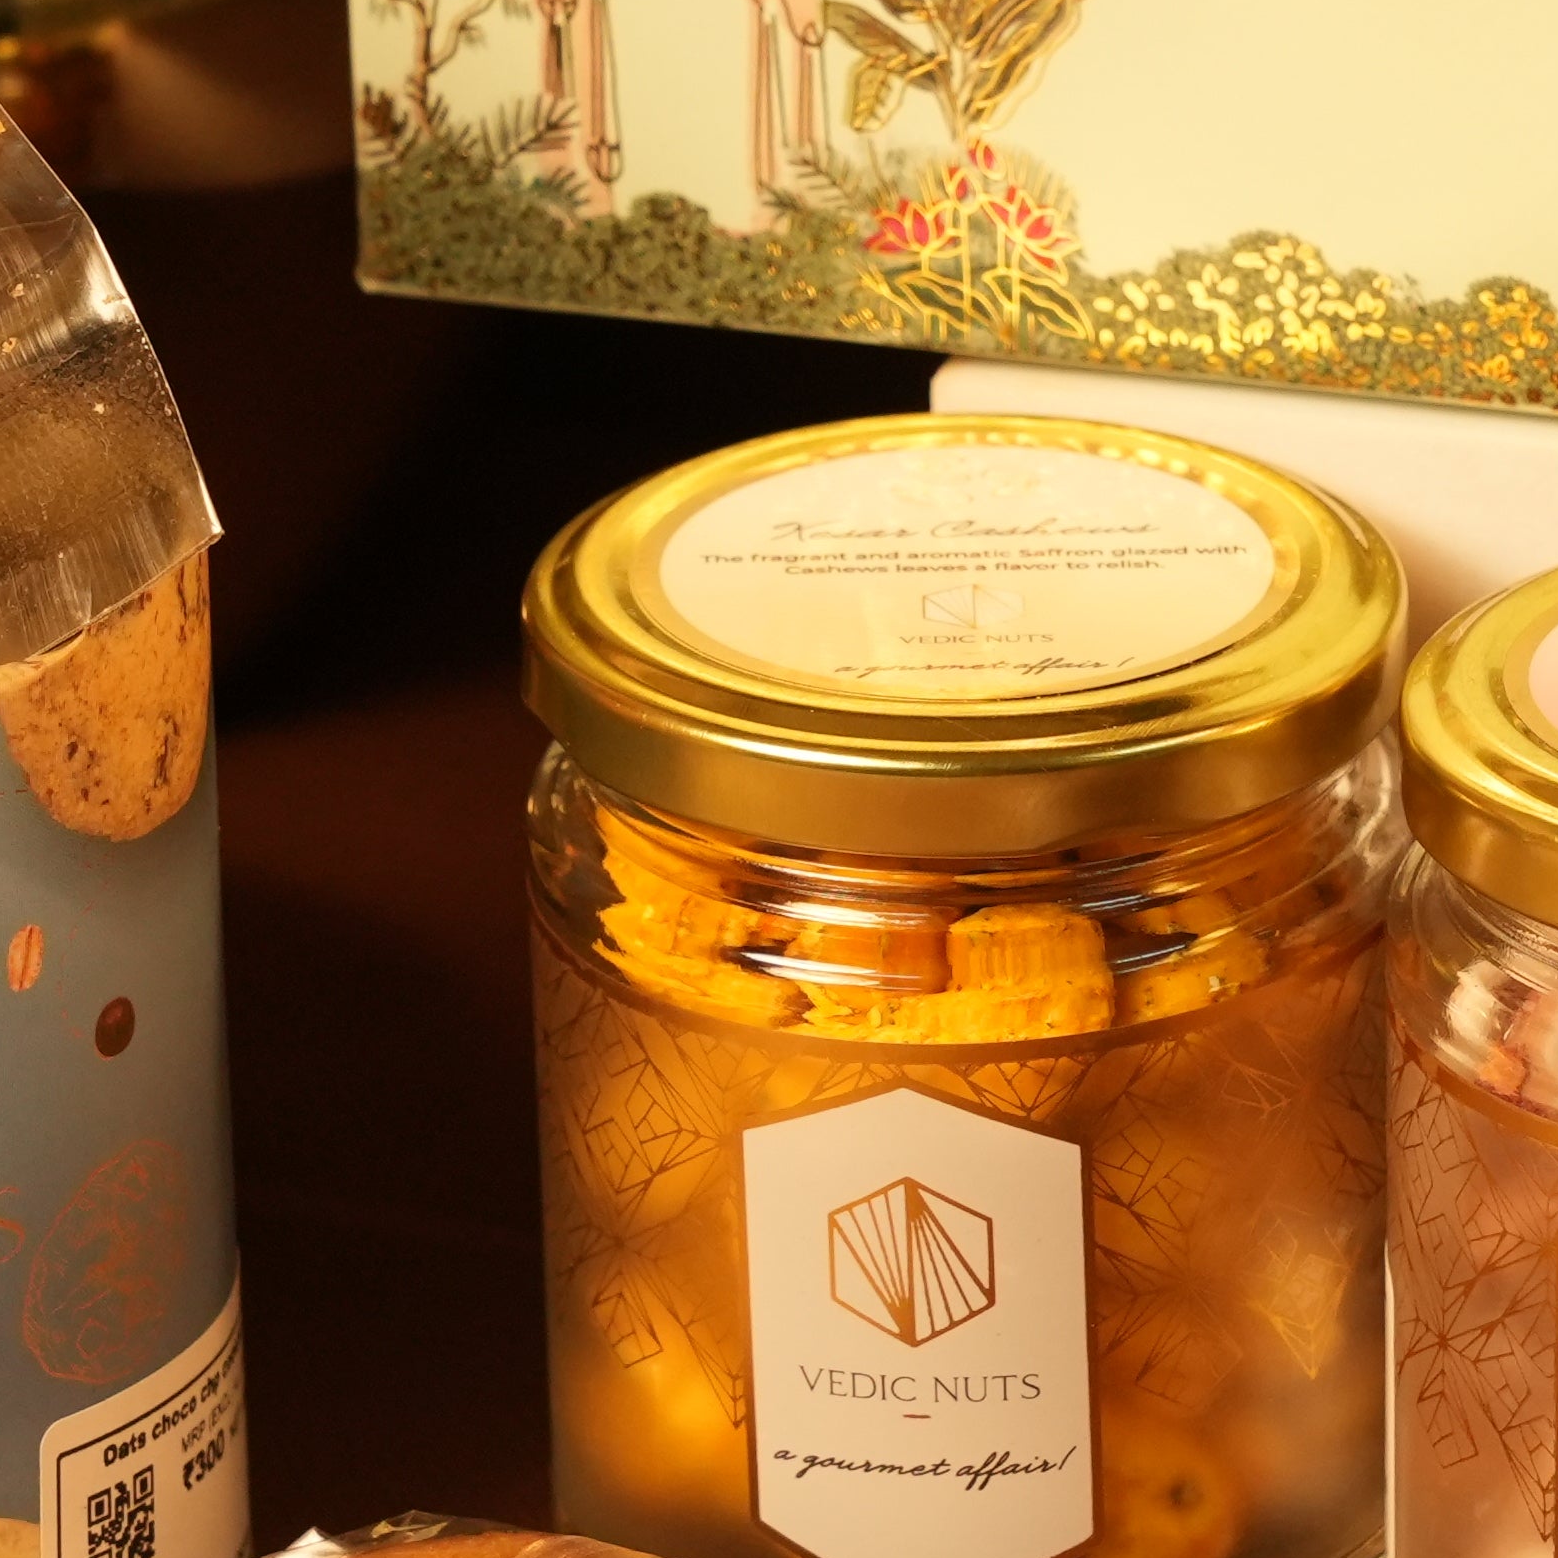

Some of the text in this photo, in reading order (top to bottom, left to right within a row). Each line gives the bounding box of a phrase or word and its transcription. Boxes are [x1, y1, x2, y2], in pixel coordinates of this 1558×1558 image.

[701, 545, 1247, 564] The fragrant and aromatic Saffron glazed with
[785, 560, 1165, 575] Cashews leaves a flavor to relish.
[899, 634, 1055, 644] VEDIC NUTS
[856, 660, 1010, 679] gourmet
[799, 1364, 1043, 1404] VEDIC NUTS
[152, 1396, 196, 1441] choco
[773, 1445, 1077, 1492] a gourmet affair!
